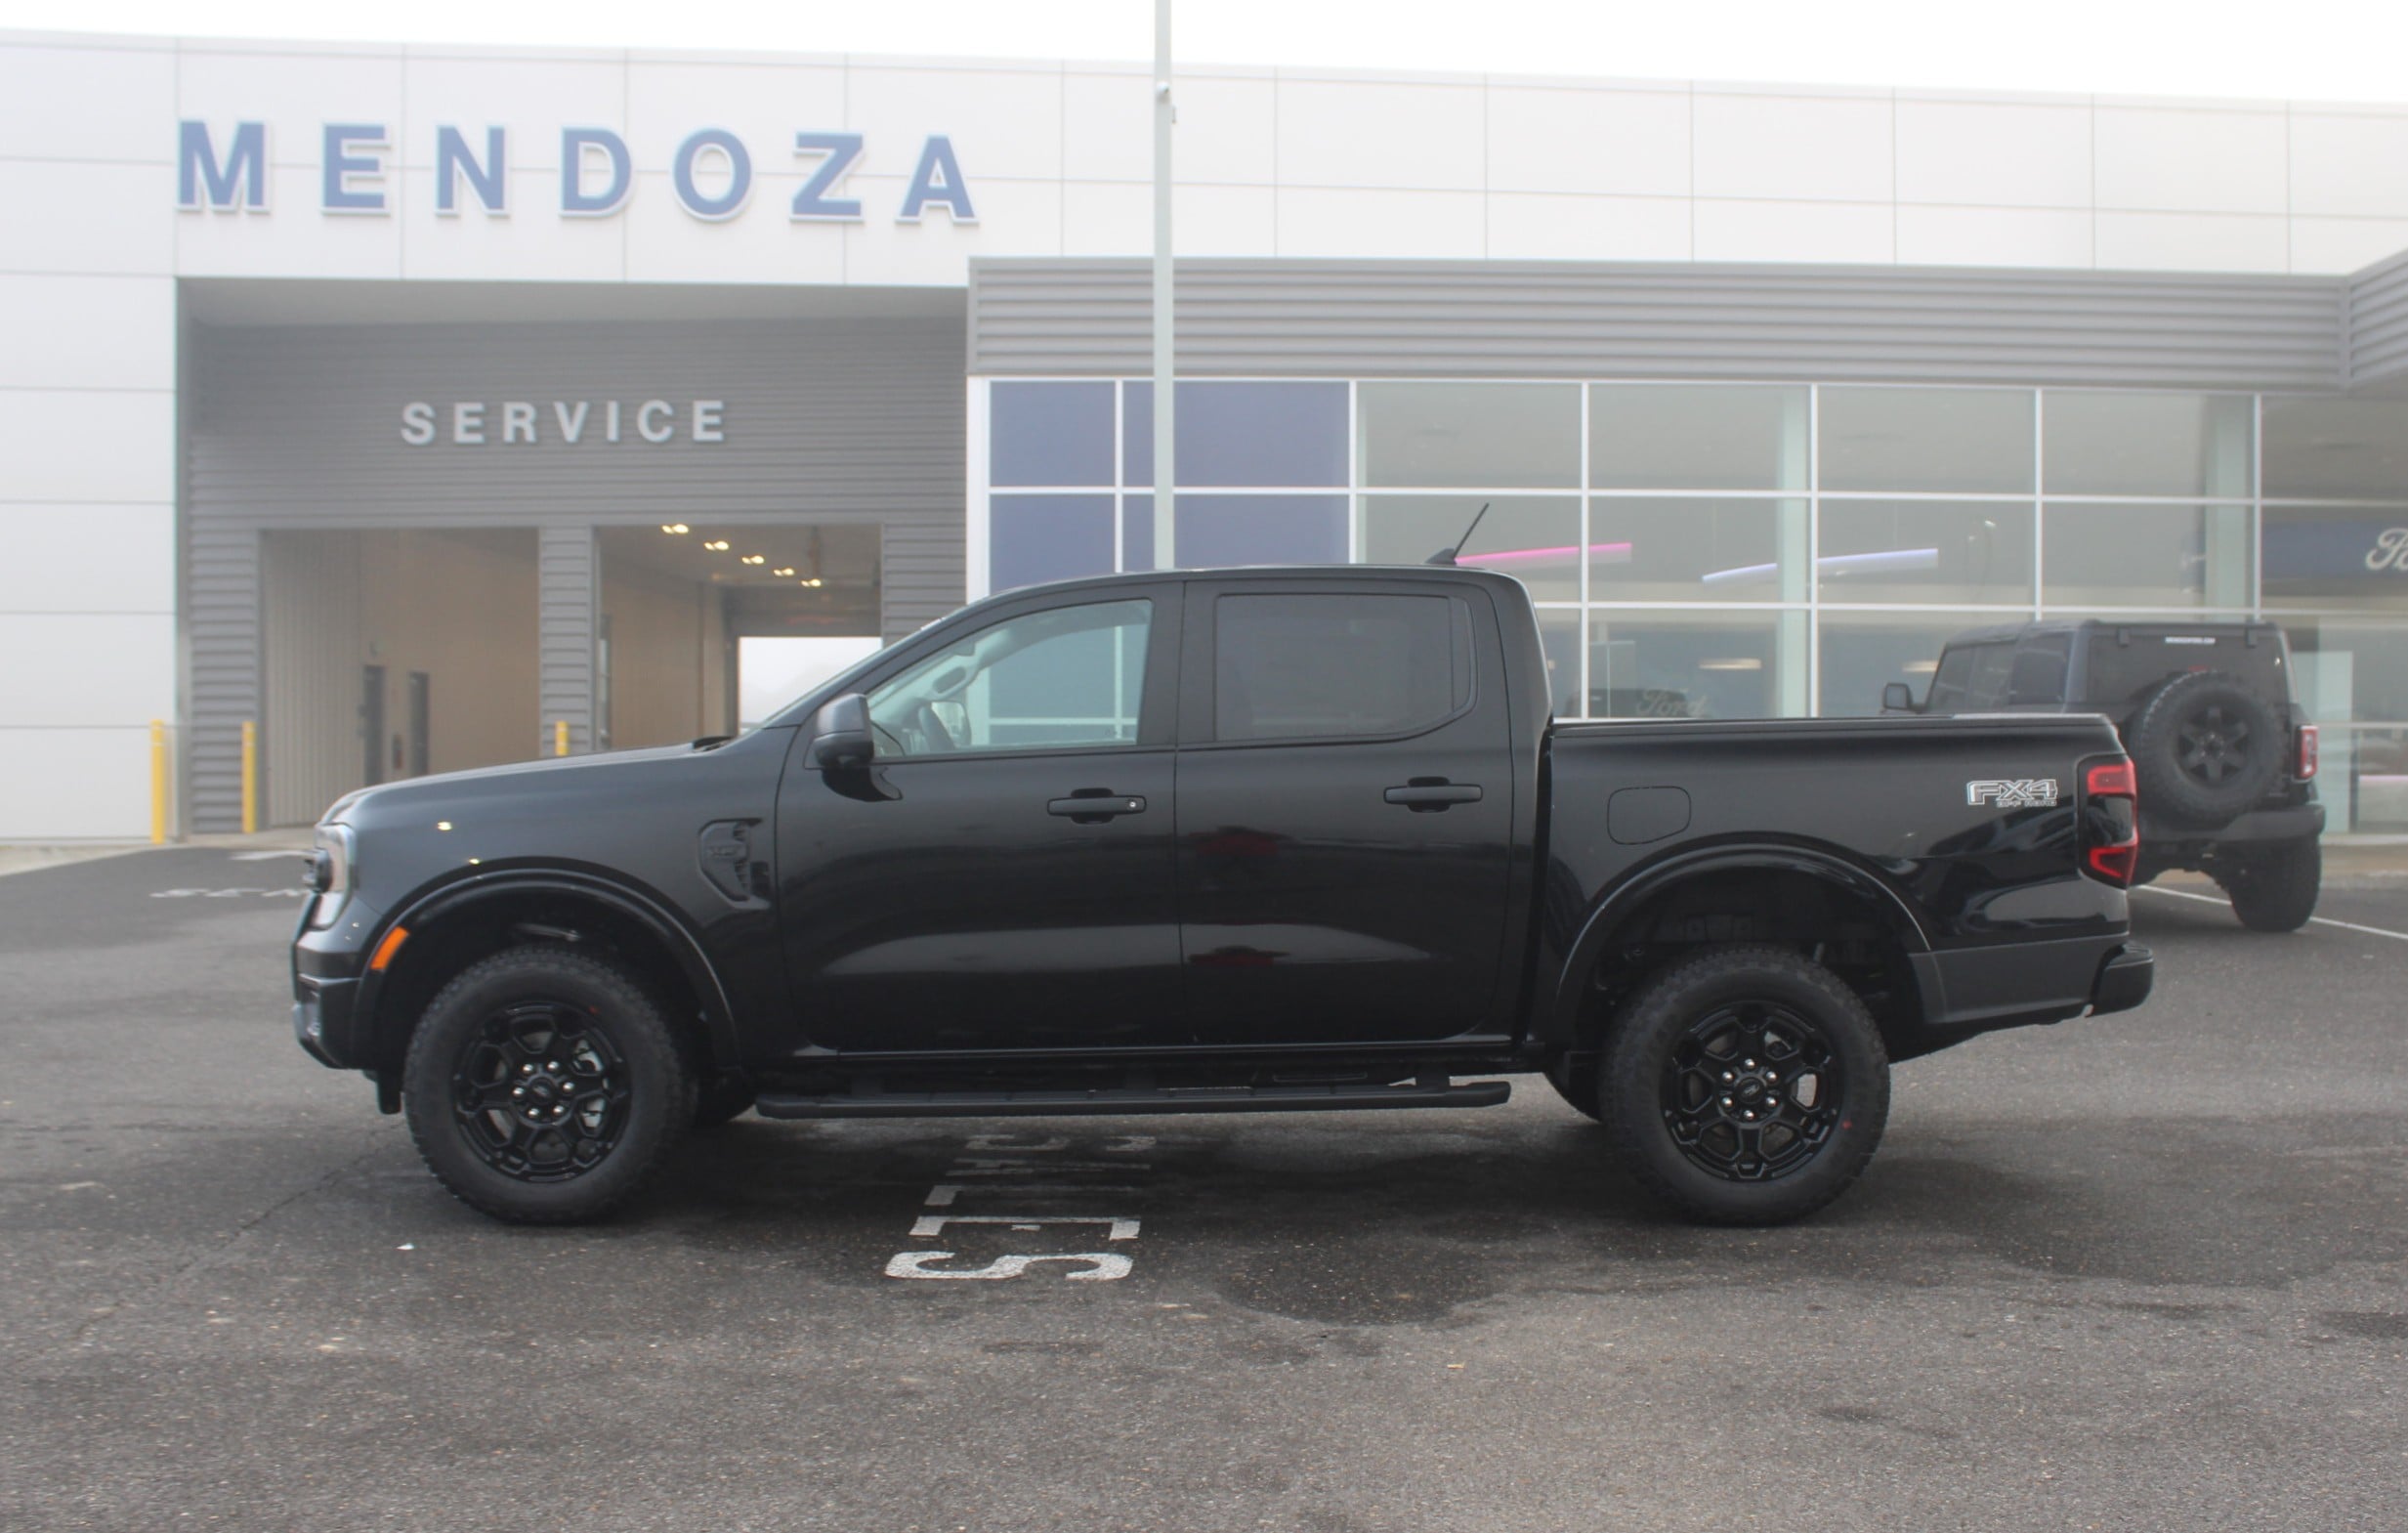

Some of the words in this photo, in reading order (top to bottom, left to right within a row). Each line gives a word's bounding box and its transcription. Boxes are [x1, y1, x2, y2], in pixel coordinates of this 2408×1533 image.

[176, 120, 977, 224] MENDOZA
[401, 399, 725, 445] SERVICE
[1966, 779, 2058, 805] FX4
